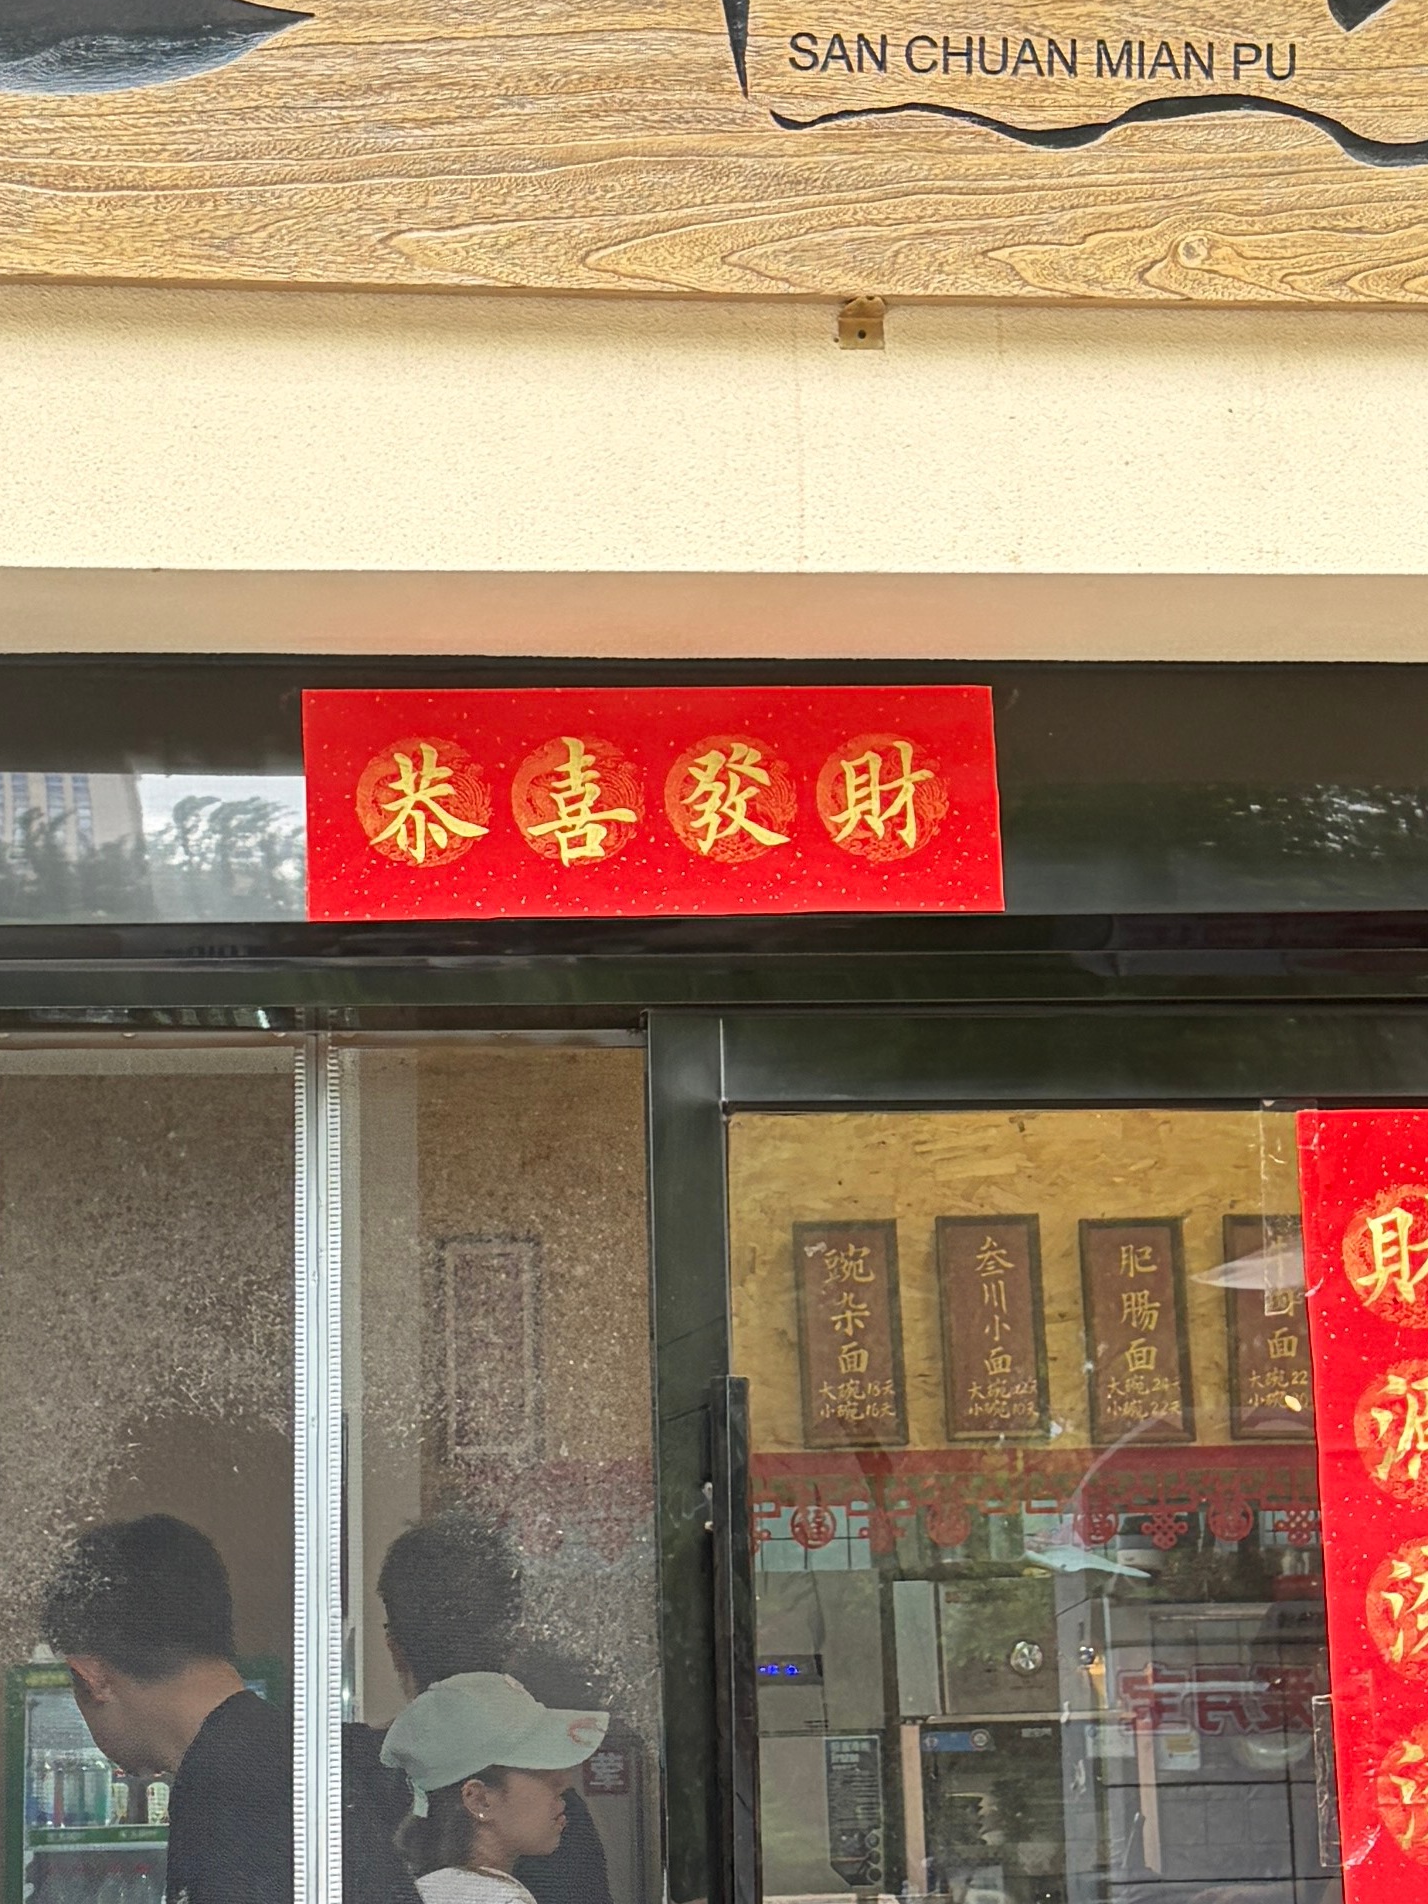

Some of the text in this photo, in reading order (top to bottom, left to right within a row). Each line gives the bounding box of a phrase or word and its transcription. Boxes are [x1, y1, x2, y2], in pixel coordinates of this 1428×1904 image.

[788, 32, 1296, 81] SAN CHUAN MIAN PU
[370, 736, 936, 868] 恭喜發財
